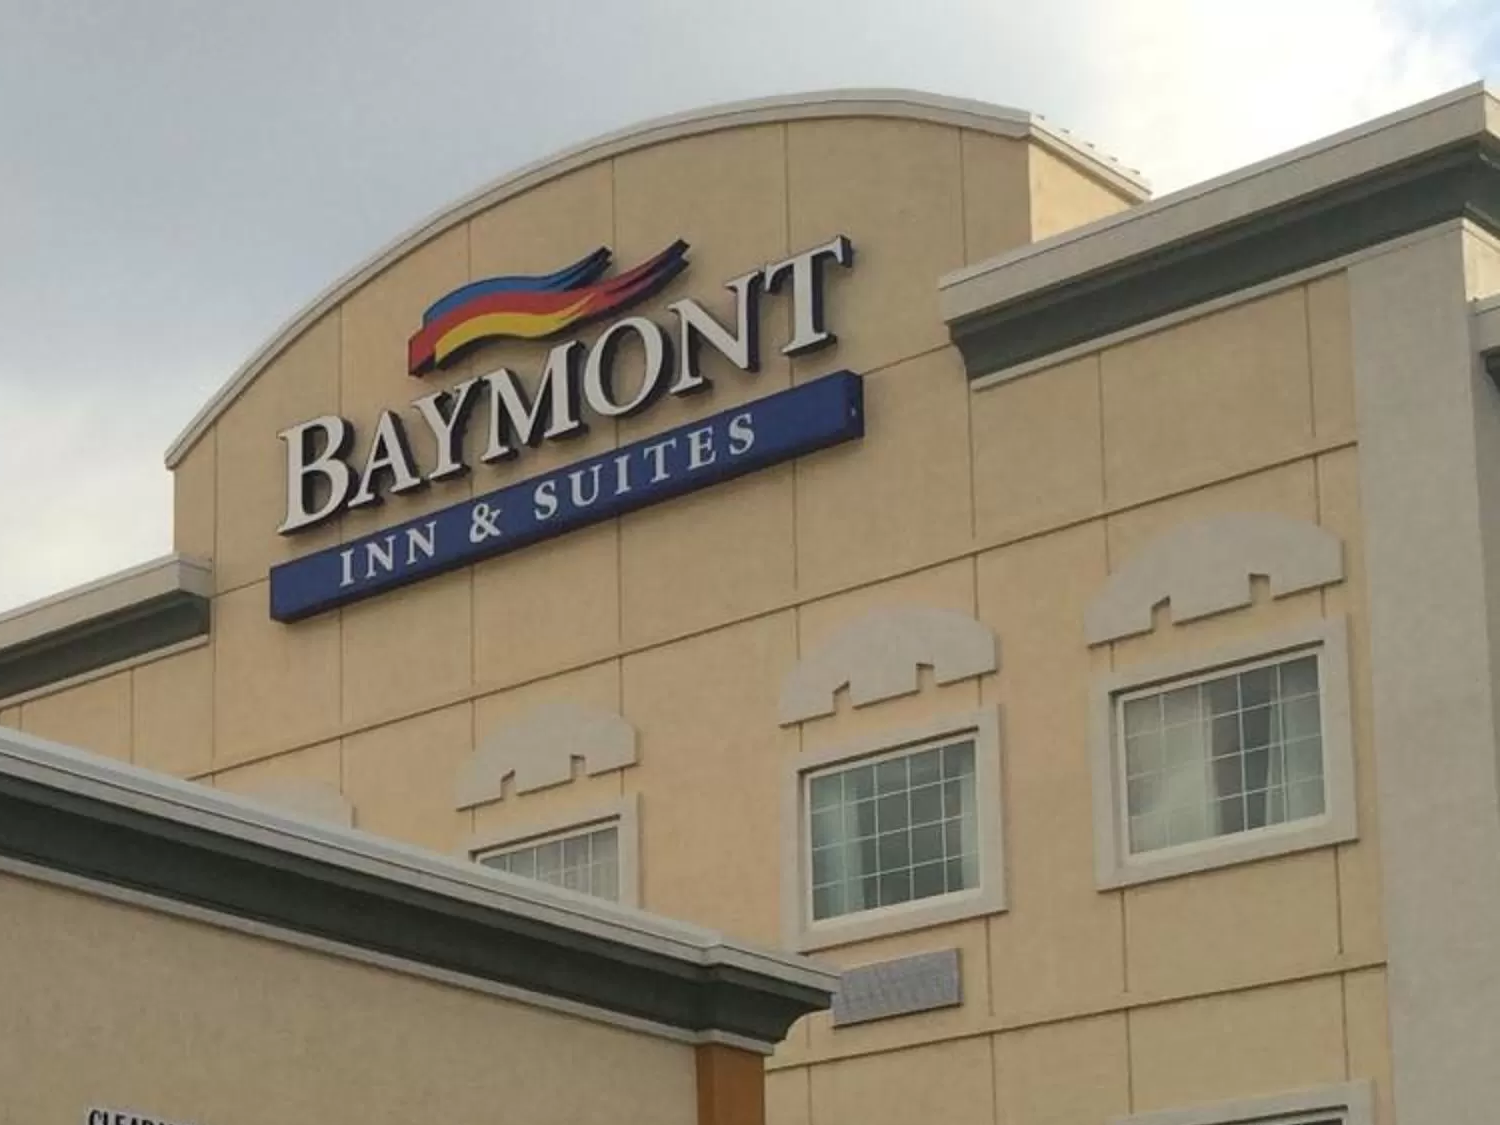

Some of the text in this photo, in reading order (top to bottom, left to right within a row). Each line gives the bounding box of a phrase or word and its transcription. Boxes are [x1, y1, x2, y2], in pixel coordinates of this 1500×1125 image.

[277, 234, 853, 536] BAYMONT
[339, 412, 756, 587] INN & SUITES
